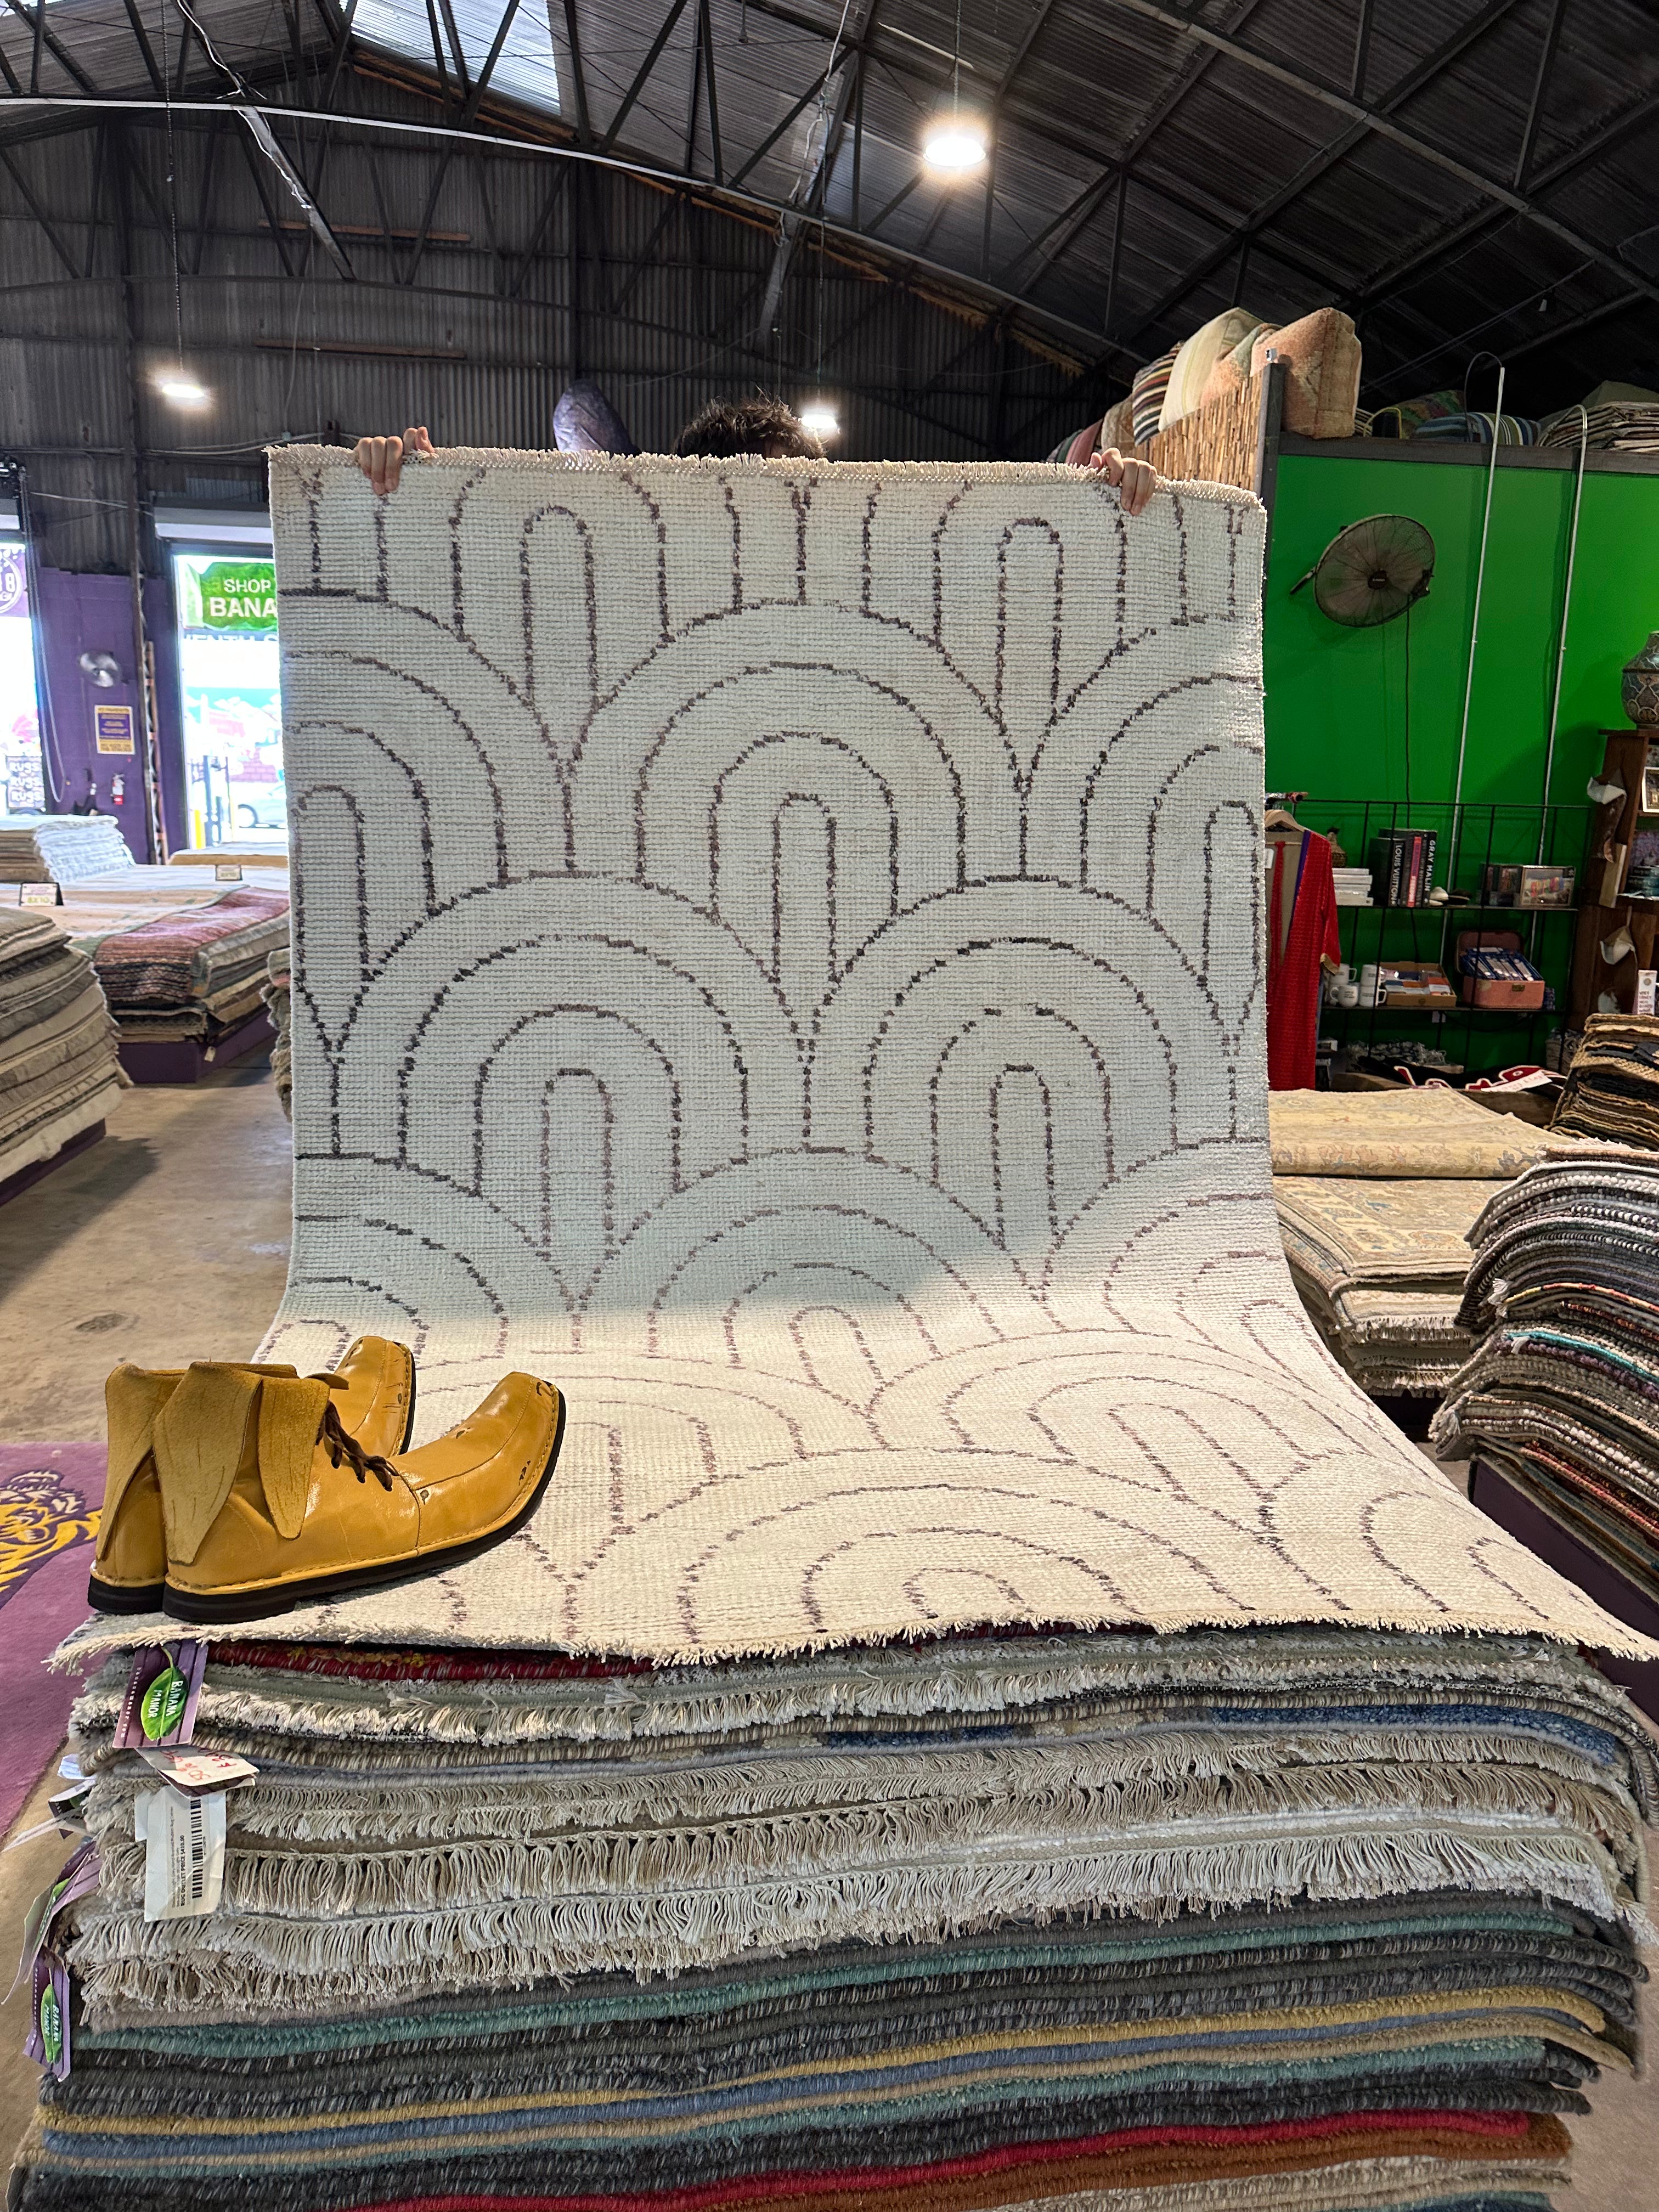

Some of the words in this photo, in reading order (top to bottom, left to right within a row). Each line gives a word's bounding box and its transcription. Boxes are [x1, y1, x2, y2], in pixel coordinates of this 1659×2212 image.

[224, 579, 272, 593] SHOP
[1394, 845, 1403, 867] LOUIS
[1391, 868, 1400, 900] VUITTON
[1424, 865, 1433, 891] MALIN
[147, 1690, 163, 1718] MANOR
[166, 1680, 184, 1717] BANANA
